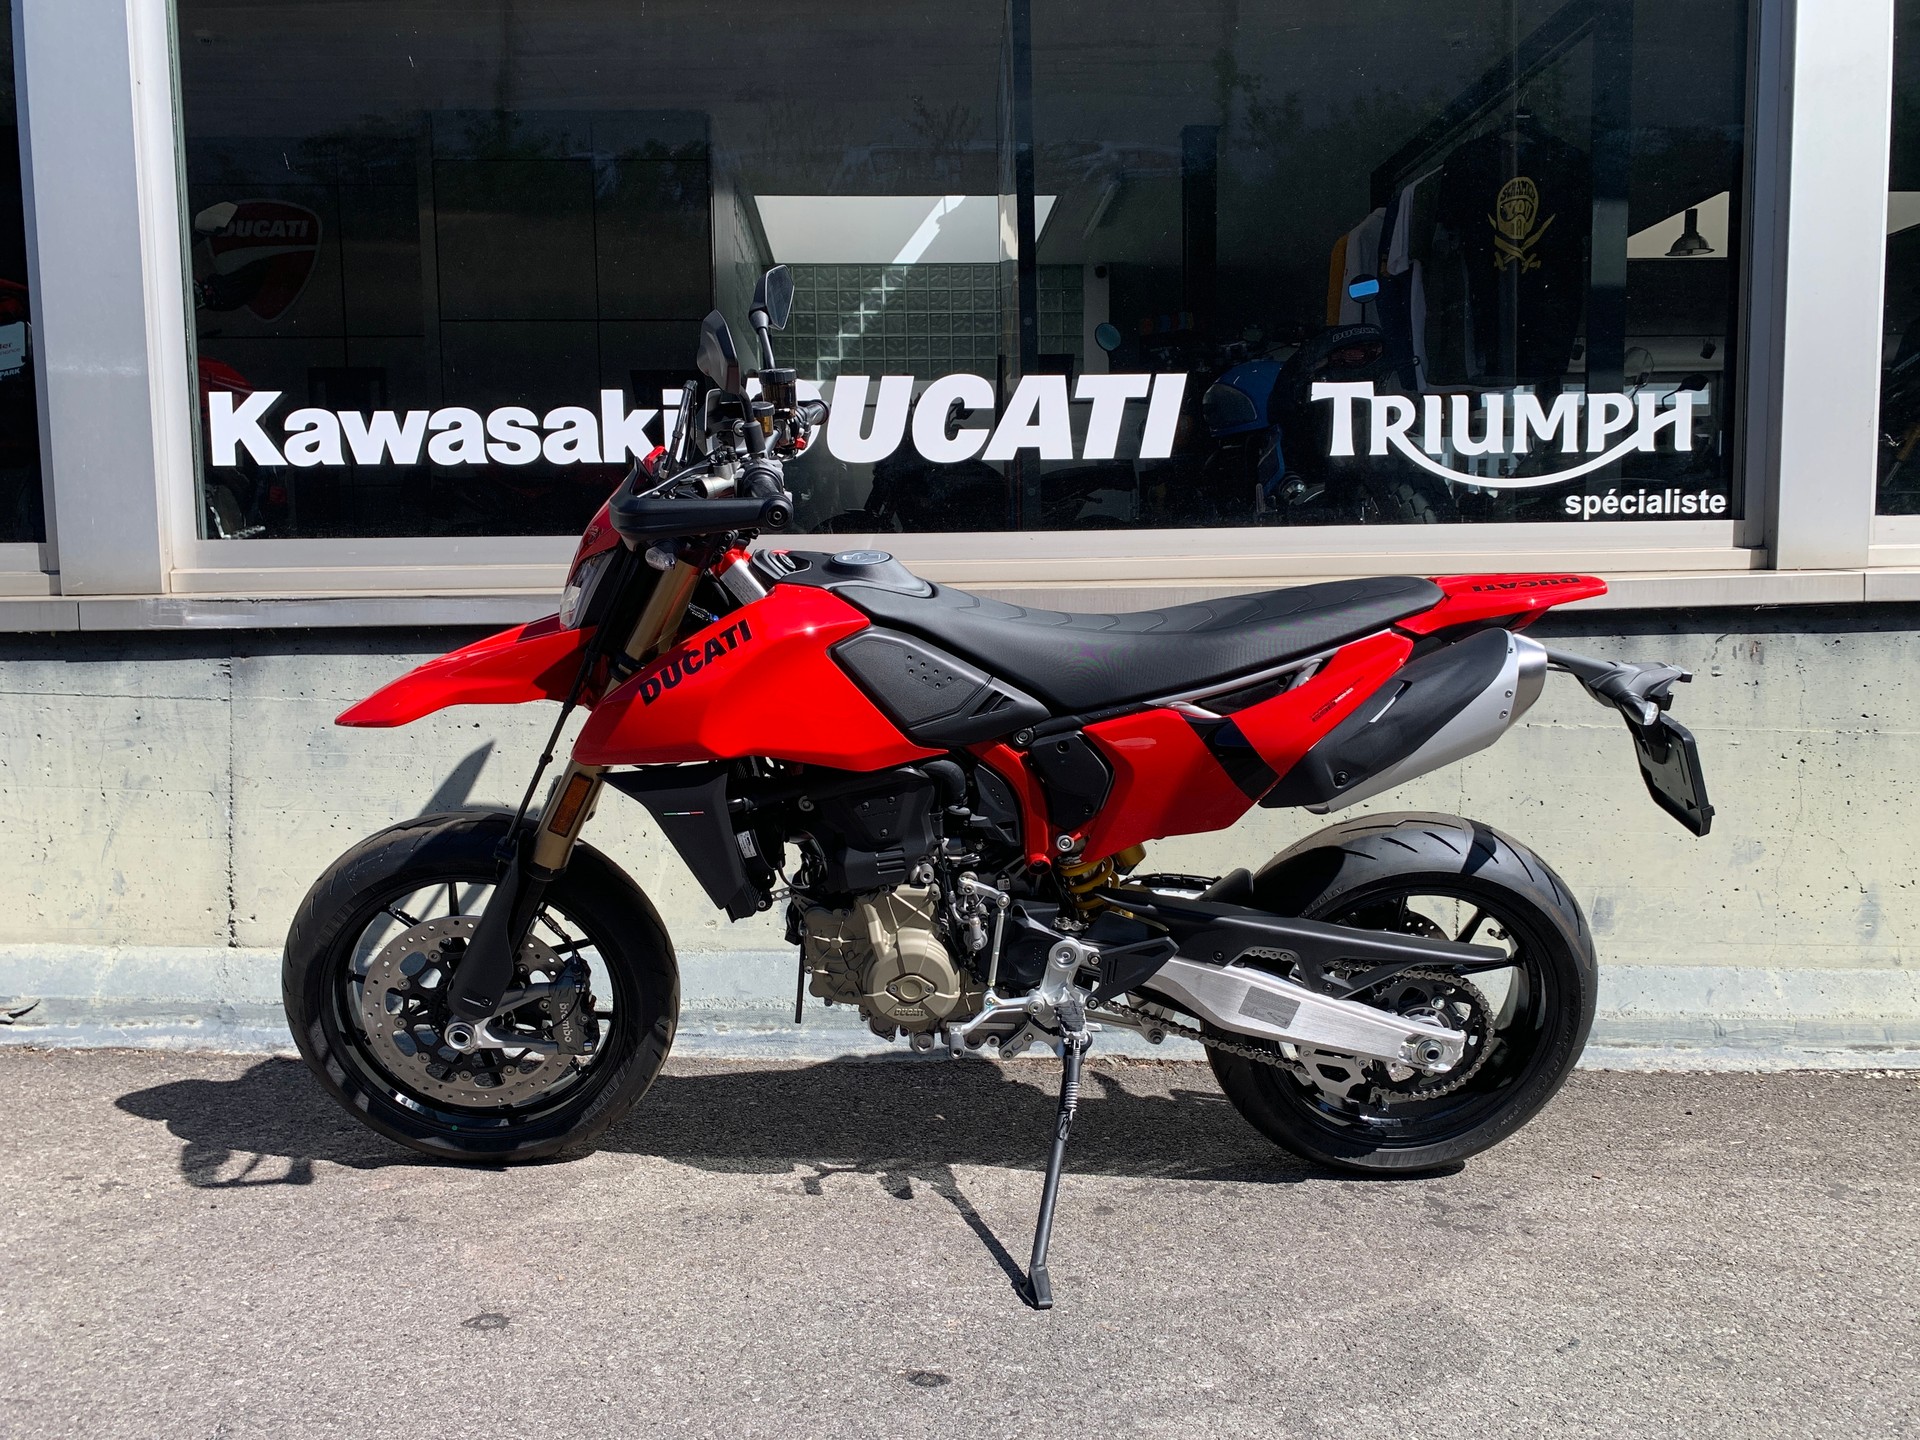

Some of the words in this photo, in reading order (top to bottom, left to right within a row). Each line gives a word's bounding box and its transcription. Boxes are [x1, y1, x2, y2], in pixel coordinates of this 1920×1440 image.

[209, 390, 686, 467] Kawasaki
[1565, 489, 1727, 520] spécialiste
[1472, 577, 1581, 592] DUCATI
[638, 618, 752, 705] DUCATI
[559, 1002, 573, 1044] brembo
[893, 1008, 925, 1017] DUCATI
